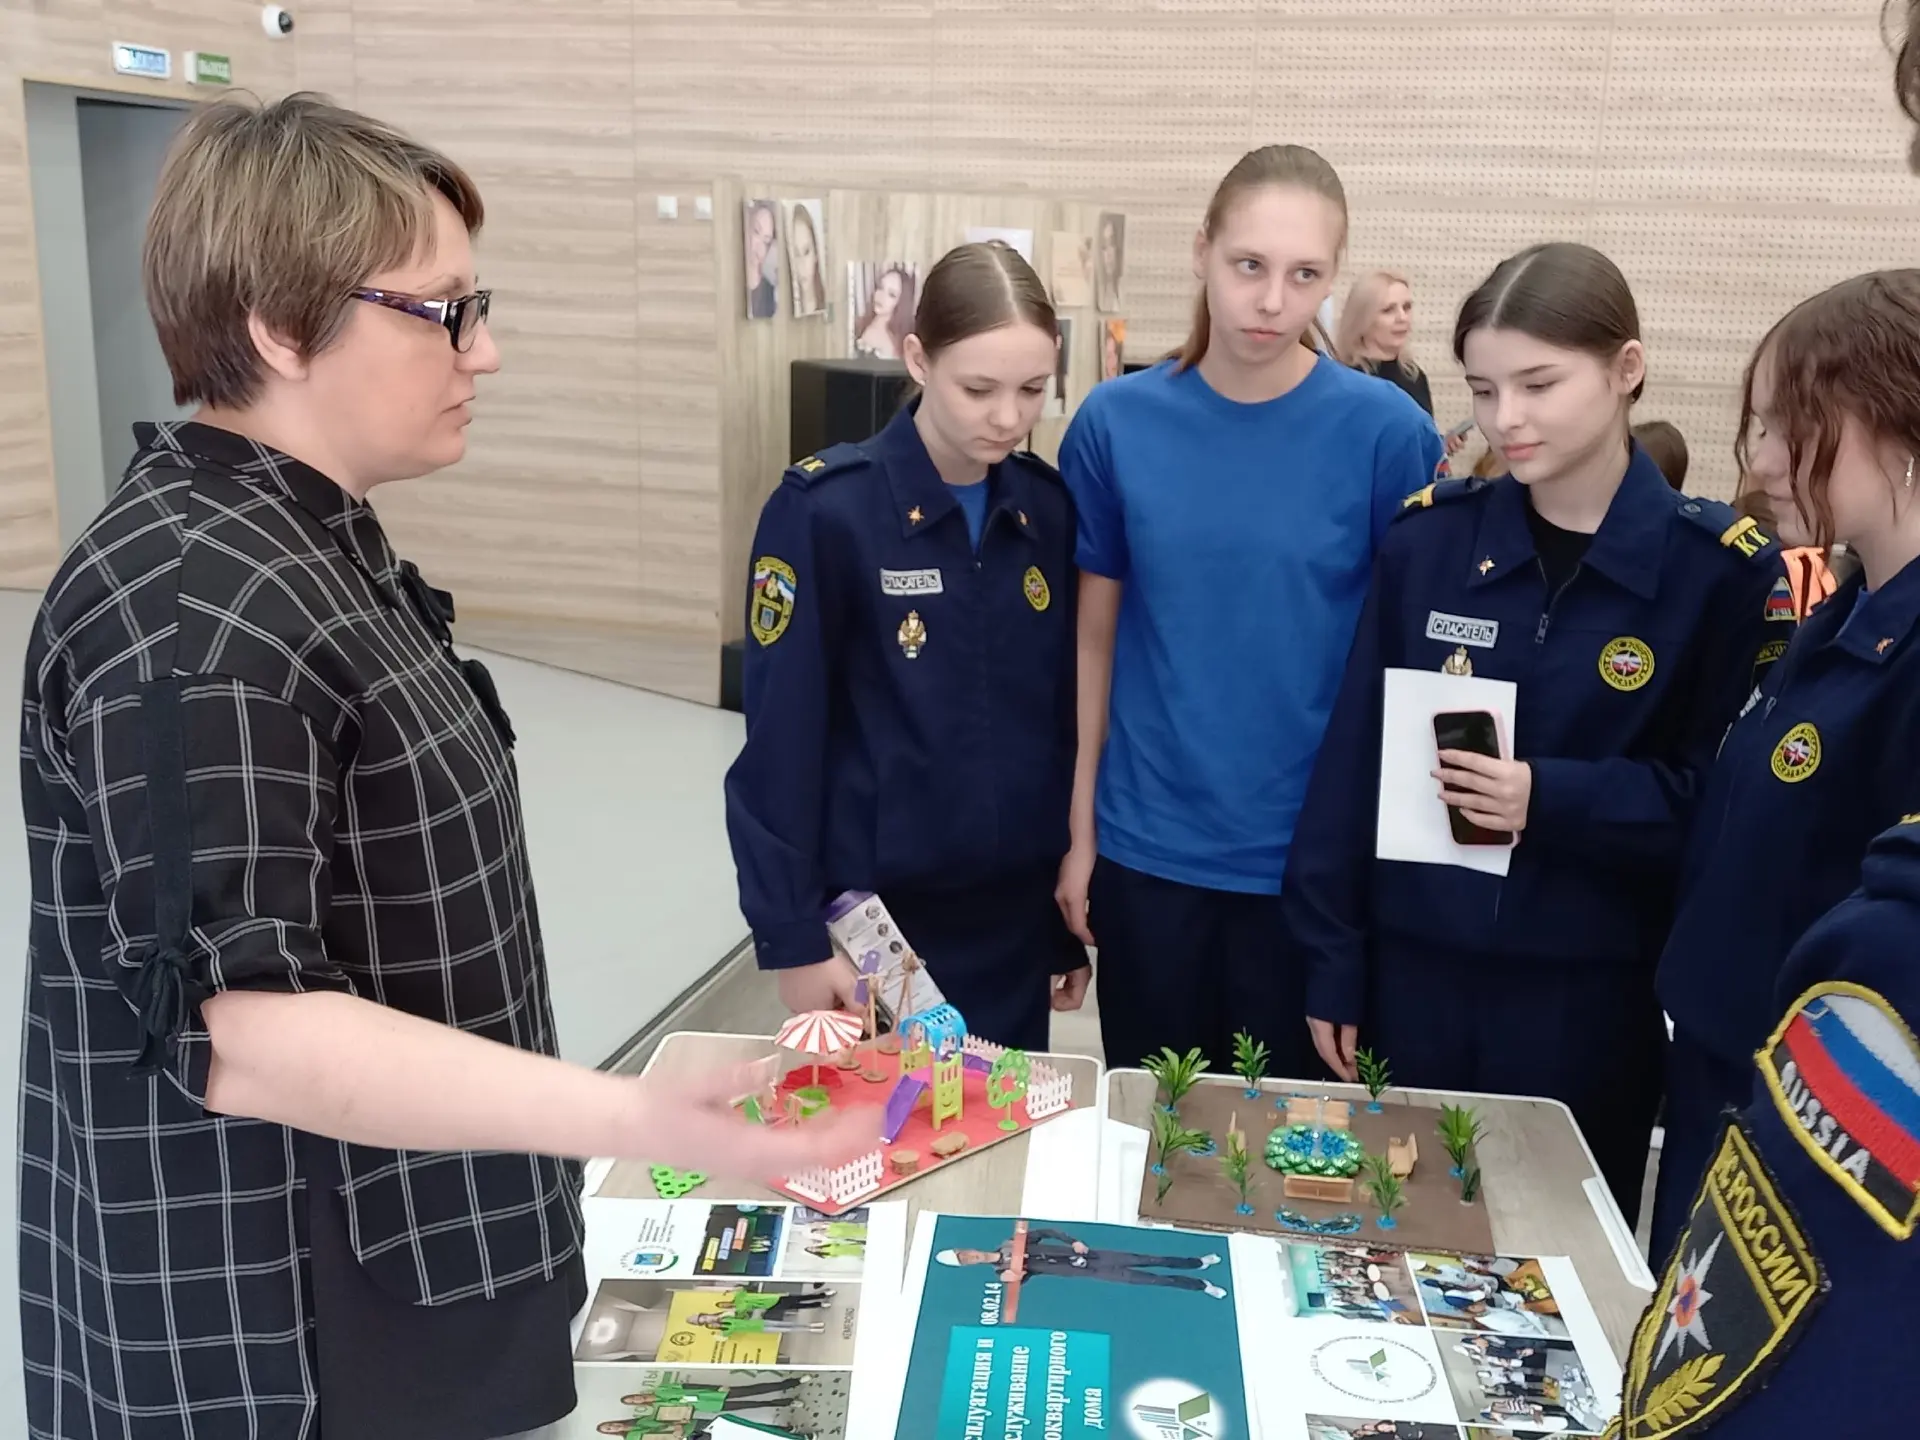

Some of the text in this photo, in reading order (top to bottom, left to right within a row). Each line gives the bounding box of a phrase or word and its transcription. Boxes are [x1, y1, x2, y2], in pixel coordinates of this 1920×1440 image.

[884, 574, 938, 589] СПАСАТЕЛЬ
[1432, 618, 1493, 642] СПАСАТЕЛЬ
[980, 1282, 1002, 1325] 08.02.14
[976, 1338, 994, 1348] и
[1083, 1387, 1105, 1429] дома
